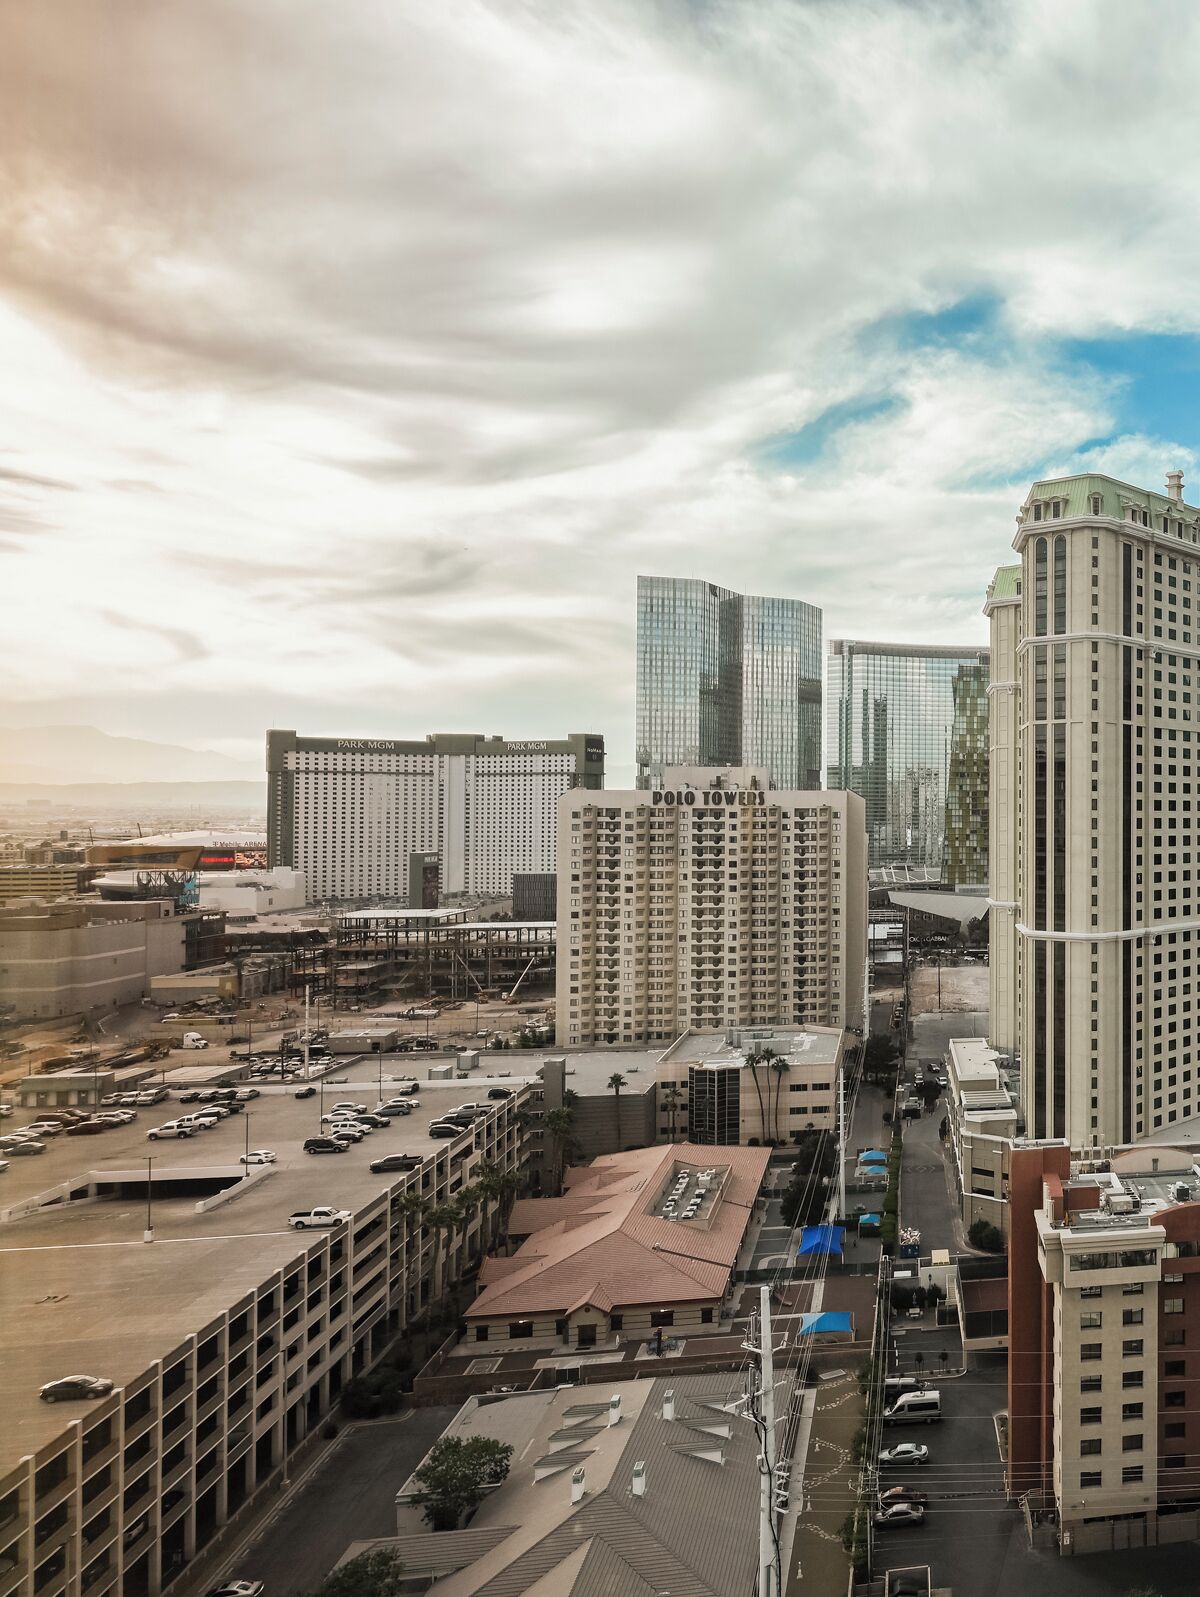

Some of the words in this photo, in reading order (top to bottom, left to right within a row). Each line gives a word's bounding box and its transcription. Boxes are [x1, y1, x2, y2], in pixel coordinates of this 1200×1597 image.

[338, 740, 365, 749] PARK
[368, 741, 395, 750] MGM
[507, 742, 526, 750] PARK
[528, 742, 547, 750] MGM
[653, 791, 695, 806] POLO
[702, 791, 765, 806] TOWERS
